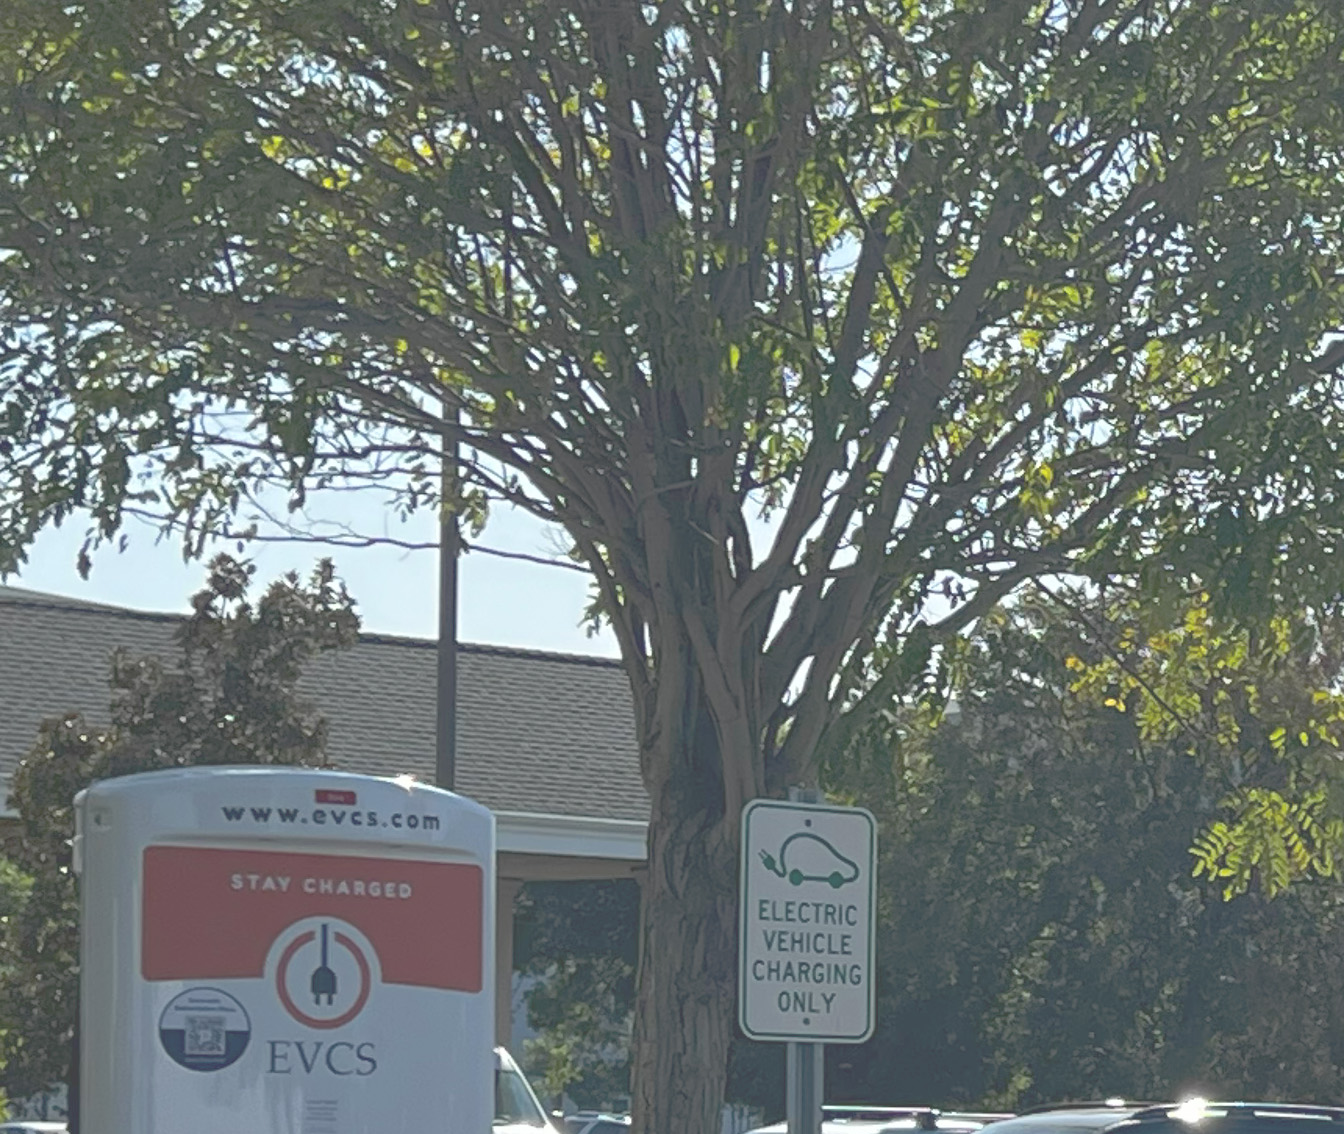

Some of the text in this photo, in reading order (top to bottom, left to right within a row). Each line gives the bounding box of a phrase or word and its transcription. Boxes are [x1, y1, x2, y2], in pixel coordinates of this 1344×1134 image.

[222, 805, 441, 831] www.evcs.com
[230, 873, 412, 899] STAY CHARGED
[758, 899, 858, 927] ELECTRIC
[762, 929, 852, 956] VEHICLE
[752, 959, 862, 986] CHARGING
[777, 990, 837, 1014] ONLY
[267, 1041, 378, 1075] EVCS
